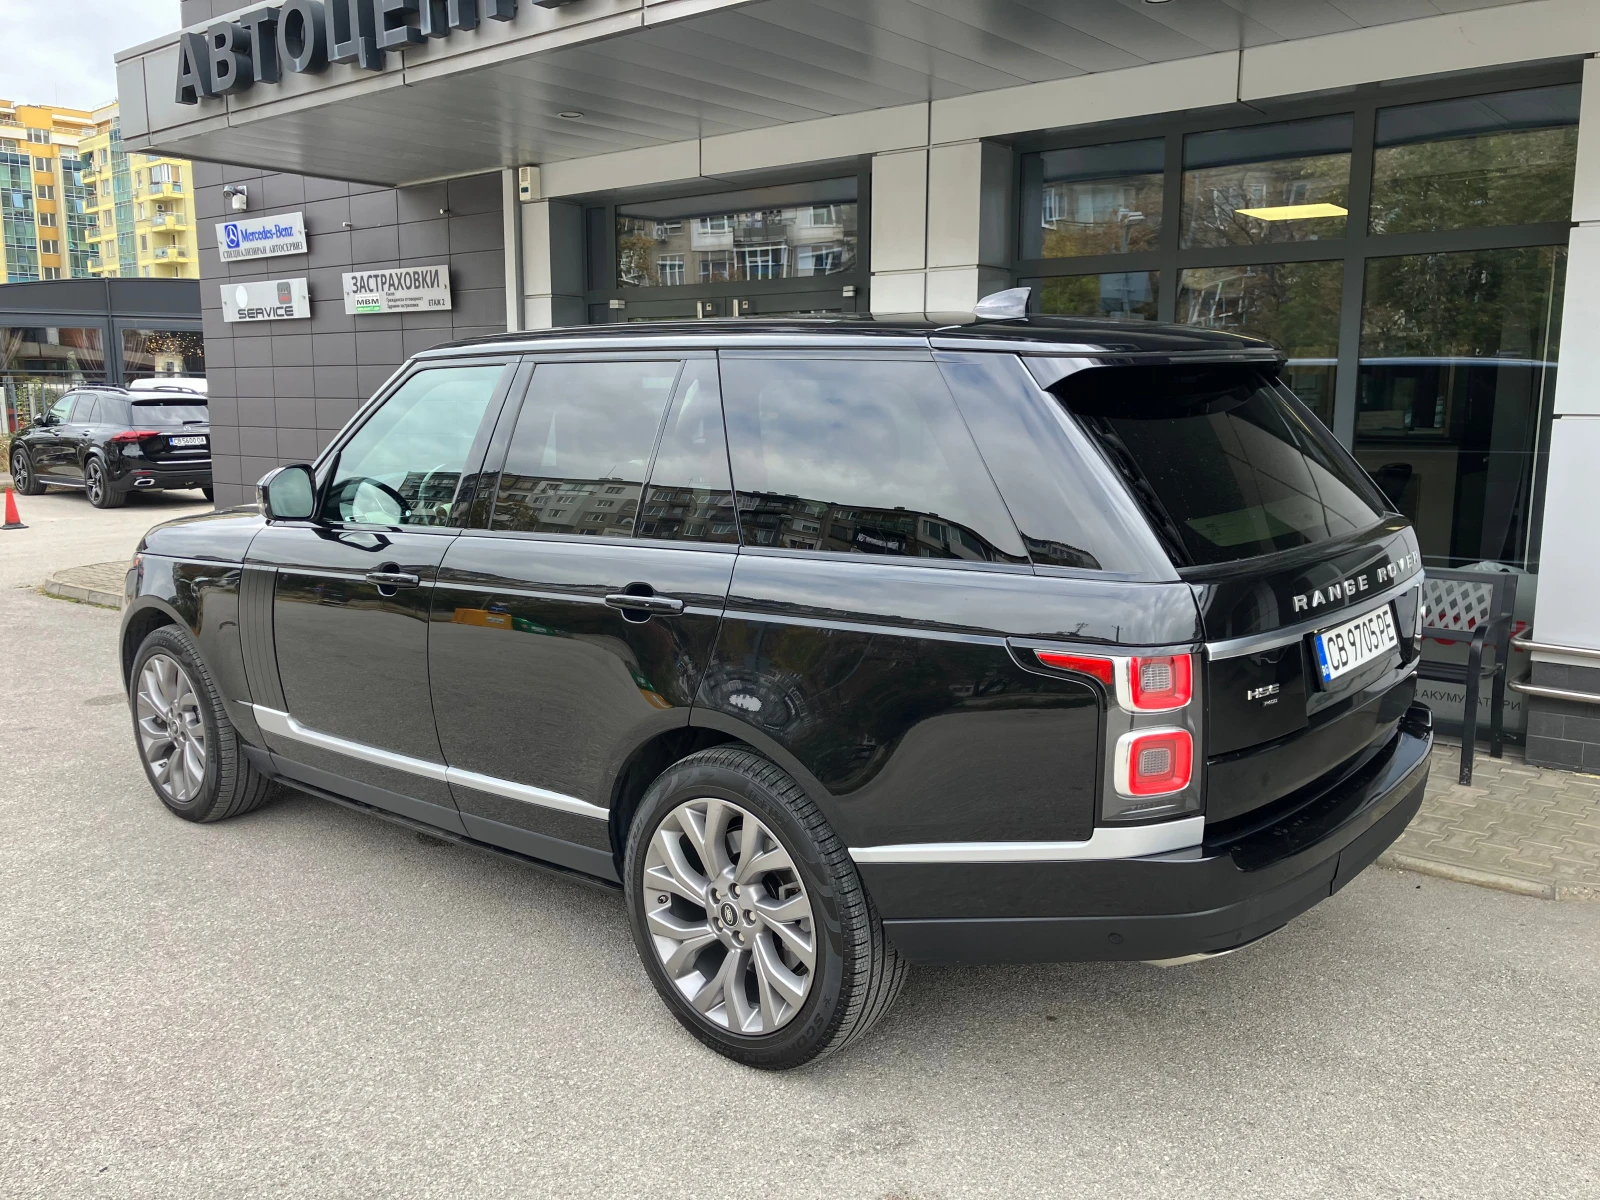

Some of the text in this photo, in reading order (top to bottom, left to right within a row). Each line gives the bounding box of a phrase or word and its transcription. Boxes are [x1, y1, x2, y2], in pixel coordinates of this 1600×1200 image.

[176, 0, 576, 105] АВТОЦЕ
[240, 224, 294, 243] Mercedes-Benz
[222, 241, 303, 259] СПЕЦИАЛИЗИРАН АВТОСЕРВИЗ
[351, 269, 440, 294] ЗАСТРАХОВКИ
[237, 305, 294, 319] SERVICE
[428, 299, 441, 307] ЕТАЖ
[1292, 550, 1418, 612] RANGE ROVER
[1347, 617, 1379, 662] 9705
[1247, 683, 1280, 701] HSE
[1420, 689, 1521, 712] АКУМУАТРИ
